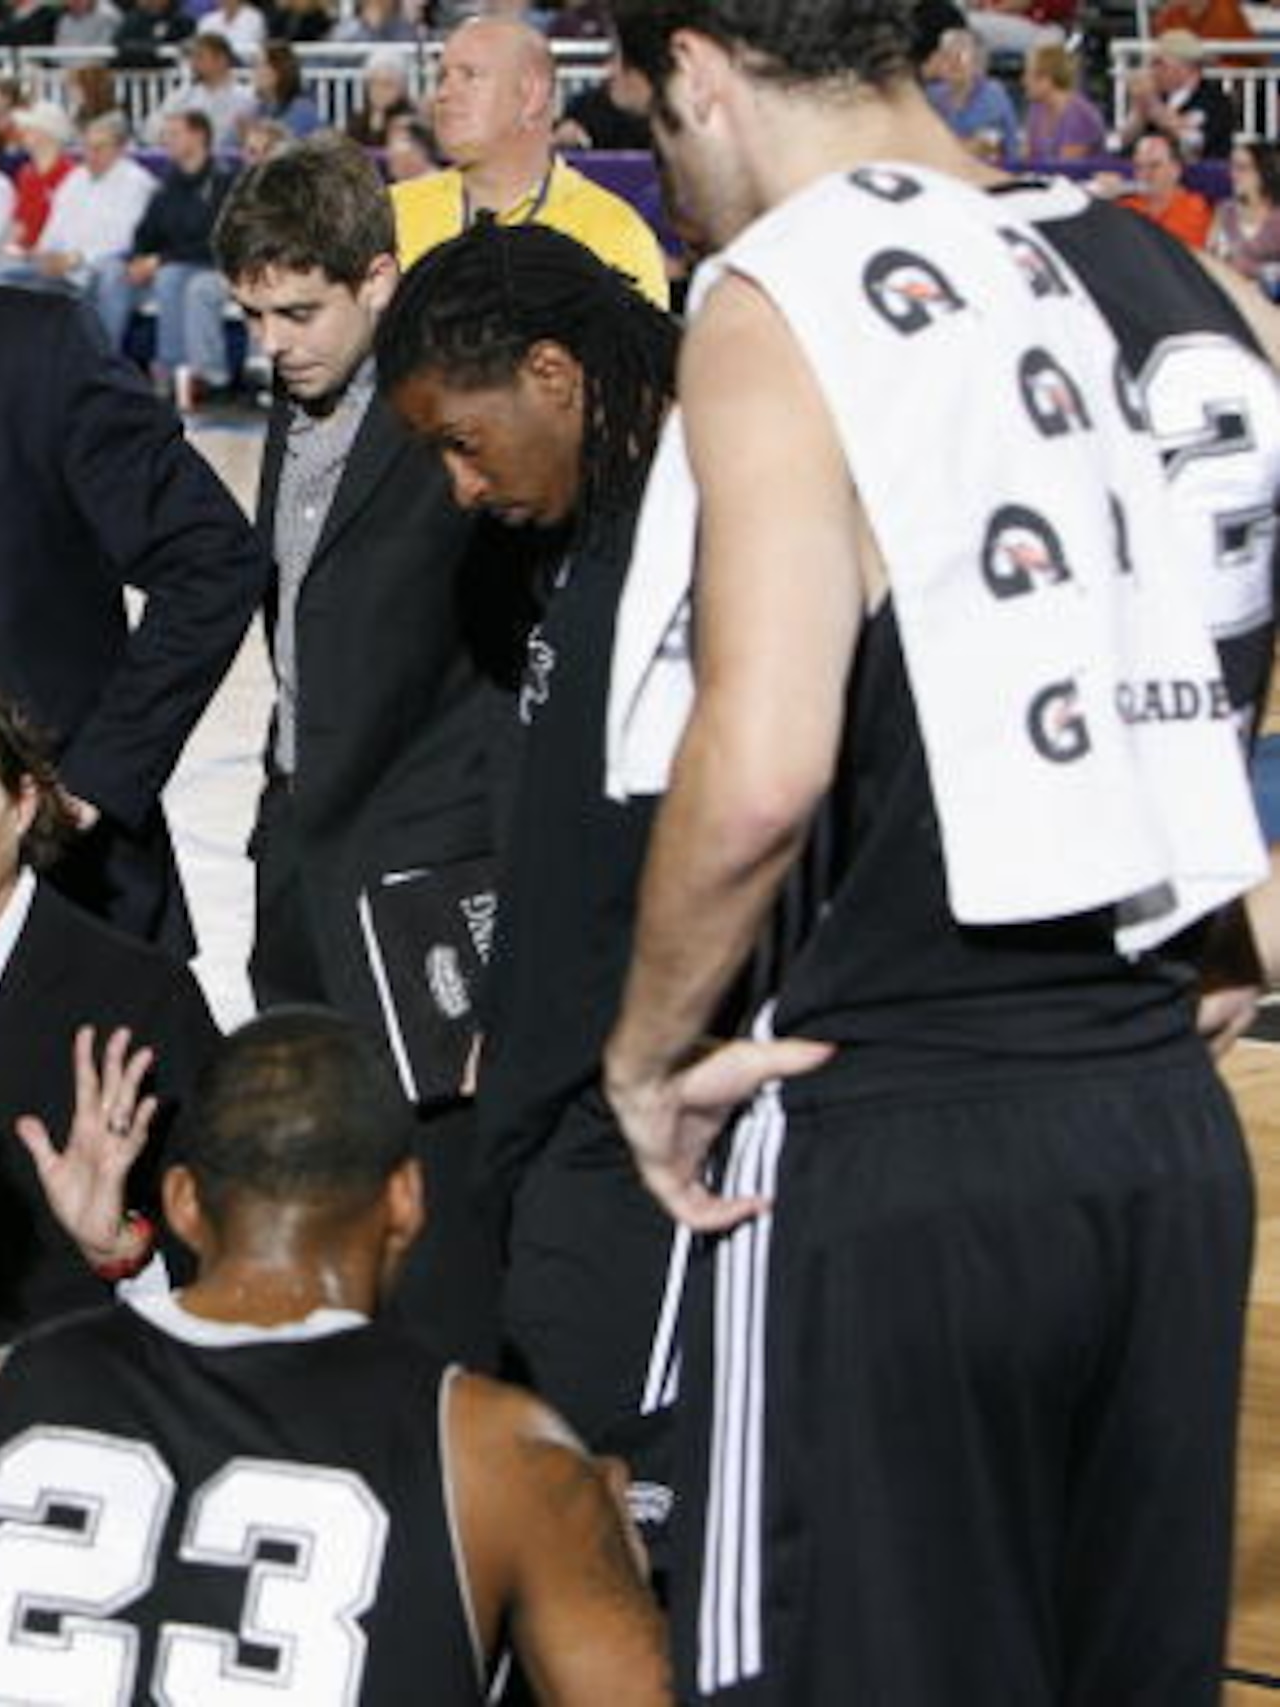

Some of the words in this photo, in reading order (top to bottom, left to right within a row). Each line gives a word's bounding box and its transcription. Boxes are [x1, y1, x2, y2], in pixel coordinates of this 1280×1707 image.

[861, 246, 967, 337] G
[1018, 345, 1092, 440] G
[980, 502, 1072, 600] G
[1027, 676, 1093, 764] G
